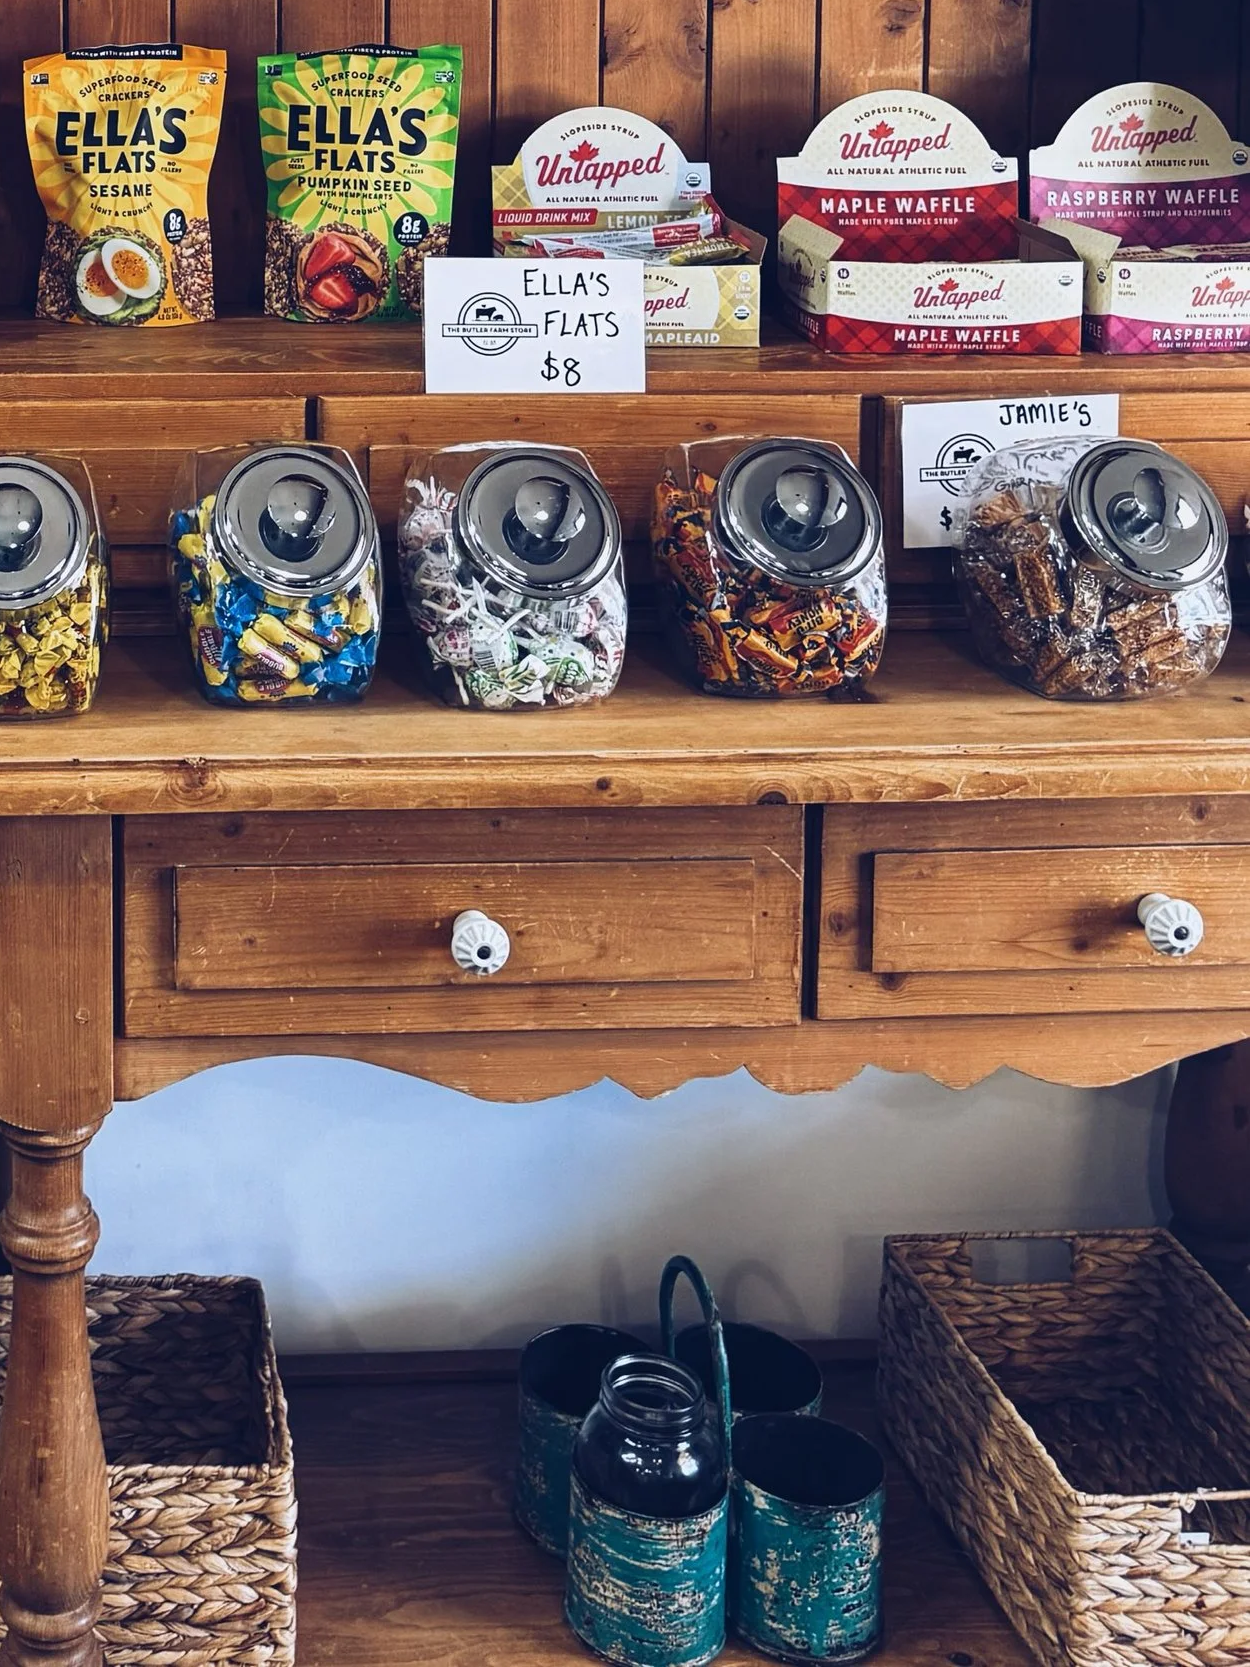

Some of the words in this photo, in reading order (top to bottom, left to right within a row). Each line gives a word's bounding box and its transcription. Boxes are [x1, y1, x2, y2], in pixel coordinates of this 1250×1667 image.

[79, 74, 141, 98] SUPERFOOD
[142, 77, 167, 93] SEED
[312, 70, 375, 91] SUPERFOOD
[376, 75, 402, 93] SEED
[98, 90, 150, 102] CRACKERS
[330, 88, 385, 98] CRACKERS
[855, 106, 903, 123] SLOPESIDE
[907, 107, 937, 123] SYRUP
[56, 107, 187, 156] ELLA'S
[287, 103, 428, 156] ELLA'S
[560, 123, 607, 140] SLOPESIDE
[612, 125, 640, 139] SYRUP
[83, 150, 156, 174] FLATS
[314, 149, 396, 174] FLATS
[827, 167, 844, 175] ALL
[848, 167, 895, 175] NATURAL
[898, 167, 942, 175] ATHLETIC
[90, 184, 152, 197] SESAME
[297, 176, 369, 191] PUMPKIN
[374, 180, 412, 192] SEED
[361, 192, 393, 200] HEARTS
[1047, 190, 1157, 207] RASPBERRY
[1165, 188, 1240, 204] WAFFLE
[351, 202, 388, 216] CRUNCHY
[821, 198, 886, 214] MAPLE
[895, 197, 975, 213] WAFFLE
[401, 215, 420, 233] 8g
[498, 213, 532, 224] LIQUID
[535, 213, 567, 223] DRINK
[571, 213, 591, 222] MIX
[607, 216, 658, 229] LEMON
[838, 218, 859, 226] MADE
[934, 217, 958, 225] SYRUP
[523, 268, 610, 297] ELLA'S
[544, 310, 619, 337] FLATS
[894, 329, 948, 342] MAPLE
[955, 329, 1020, 342] WAFFLE
[1152, 328, 1243, 341] RASPBERRY
[541, 351, 581, 386] $8
[999, 401, 1092, 427] JAMIE'S
[939, 506, 953, 531] $
[788, 603, 823, 630] HONEY
